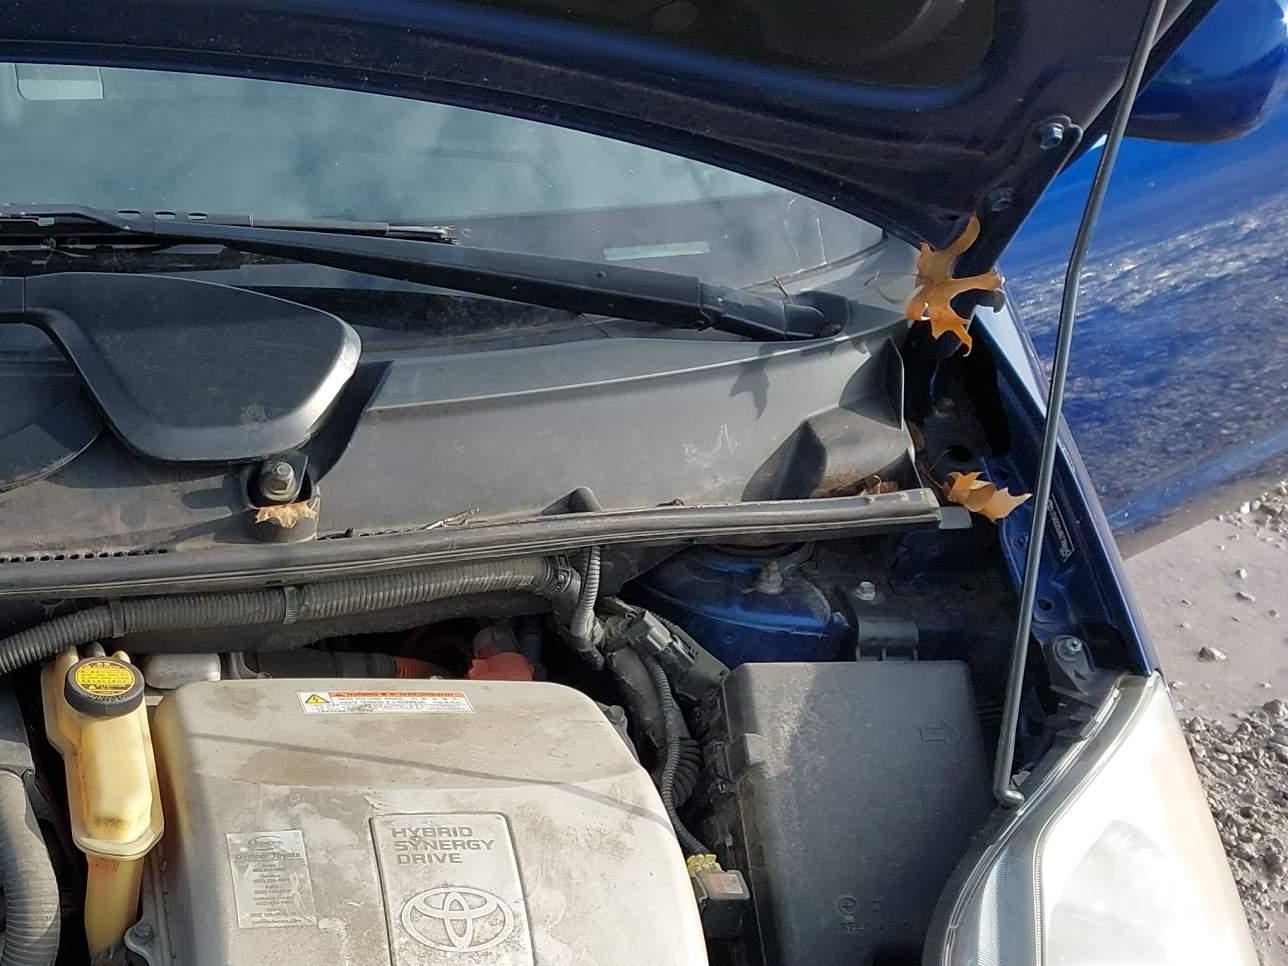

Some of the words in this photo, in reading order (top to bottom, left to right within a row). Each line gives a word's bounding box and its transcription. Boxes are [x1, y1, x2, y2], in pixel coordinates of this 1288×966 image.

[391, 826, 474, 839] HYBRID
[393, 839, 496, 852] SYNERGY
[398, 852, 463, 865] DRIVE
